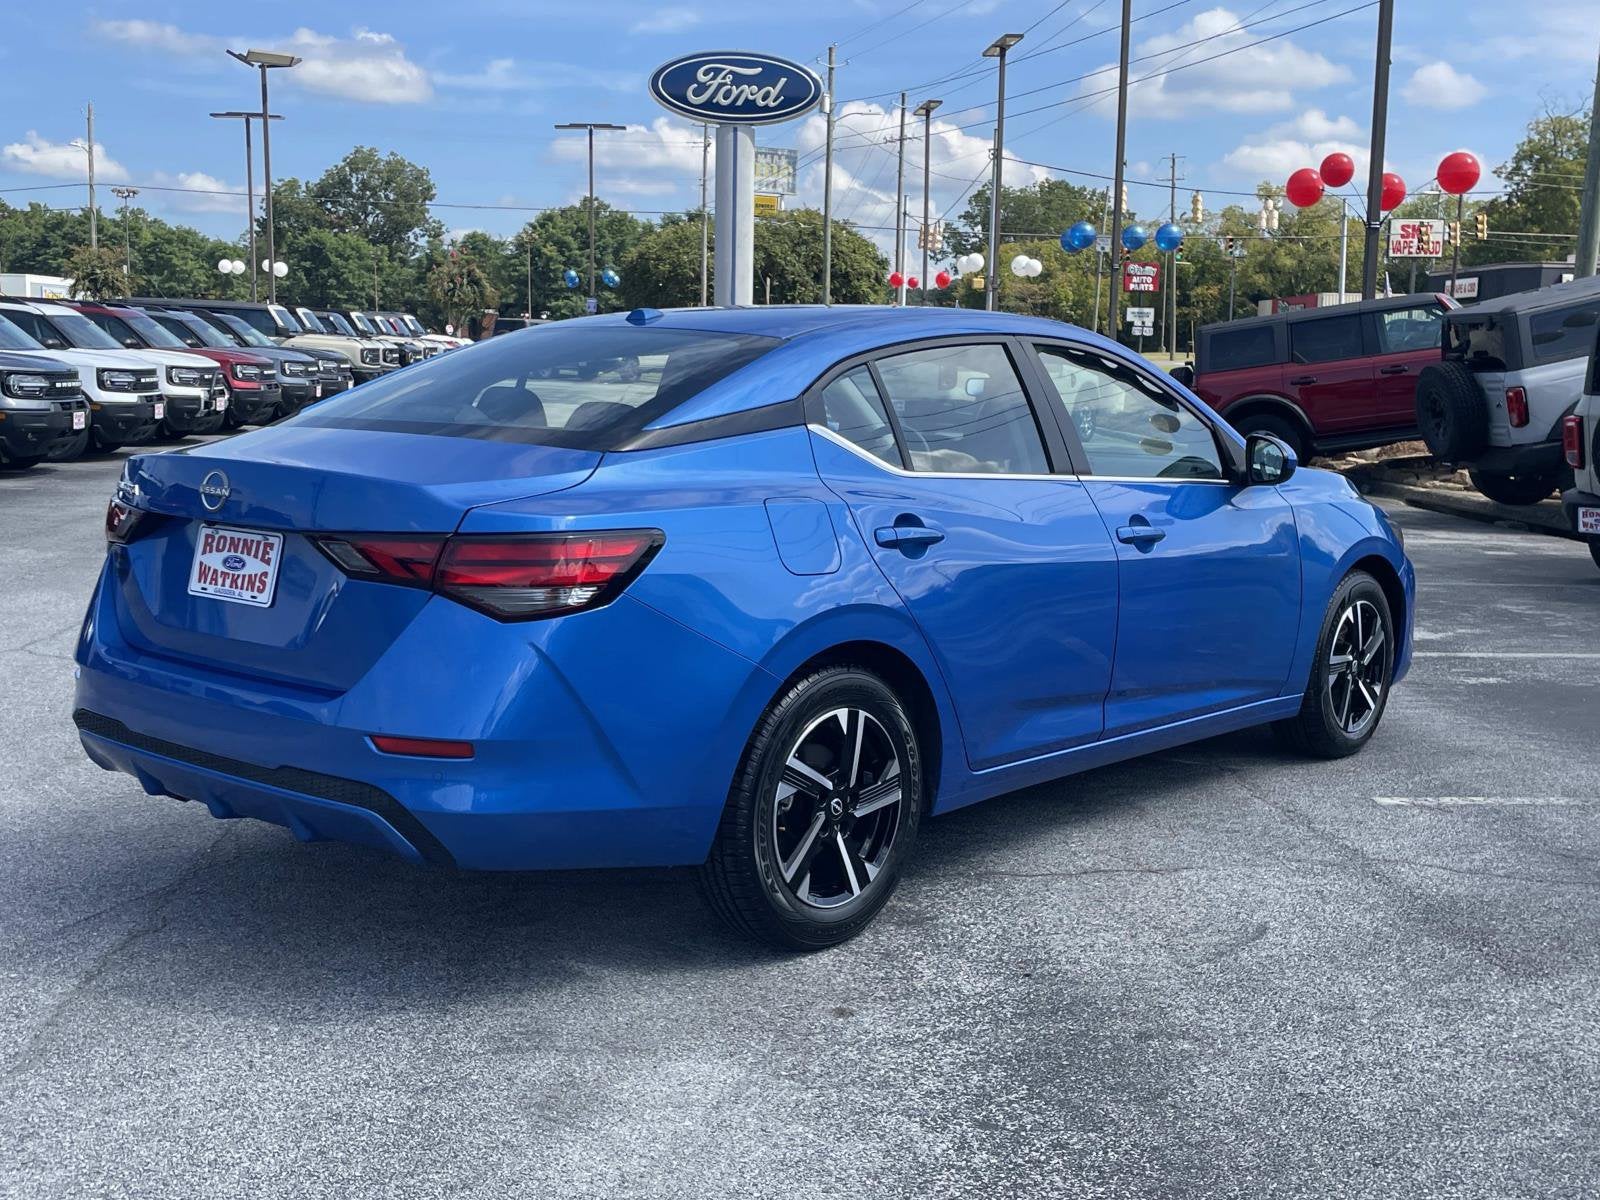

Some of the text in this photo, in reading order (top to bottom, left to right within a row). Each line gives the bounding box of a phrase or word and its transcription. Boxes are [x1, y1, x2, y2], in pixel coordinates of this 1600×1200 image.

[686, 63, 788, 107] Ford
[1391, 240, 1414, 255] VAPE
[1129, 283, 1154, 291] PARTS
[200, 485, 230, 497] SSAN
[201, 533, 275, 566] RONNIE
[225, 557, 244, 569] Ford
[197, 560, 269, 594] WATKINS
